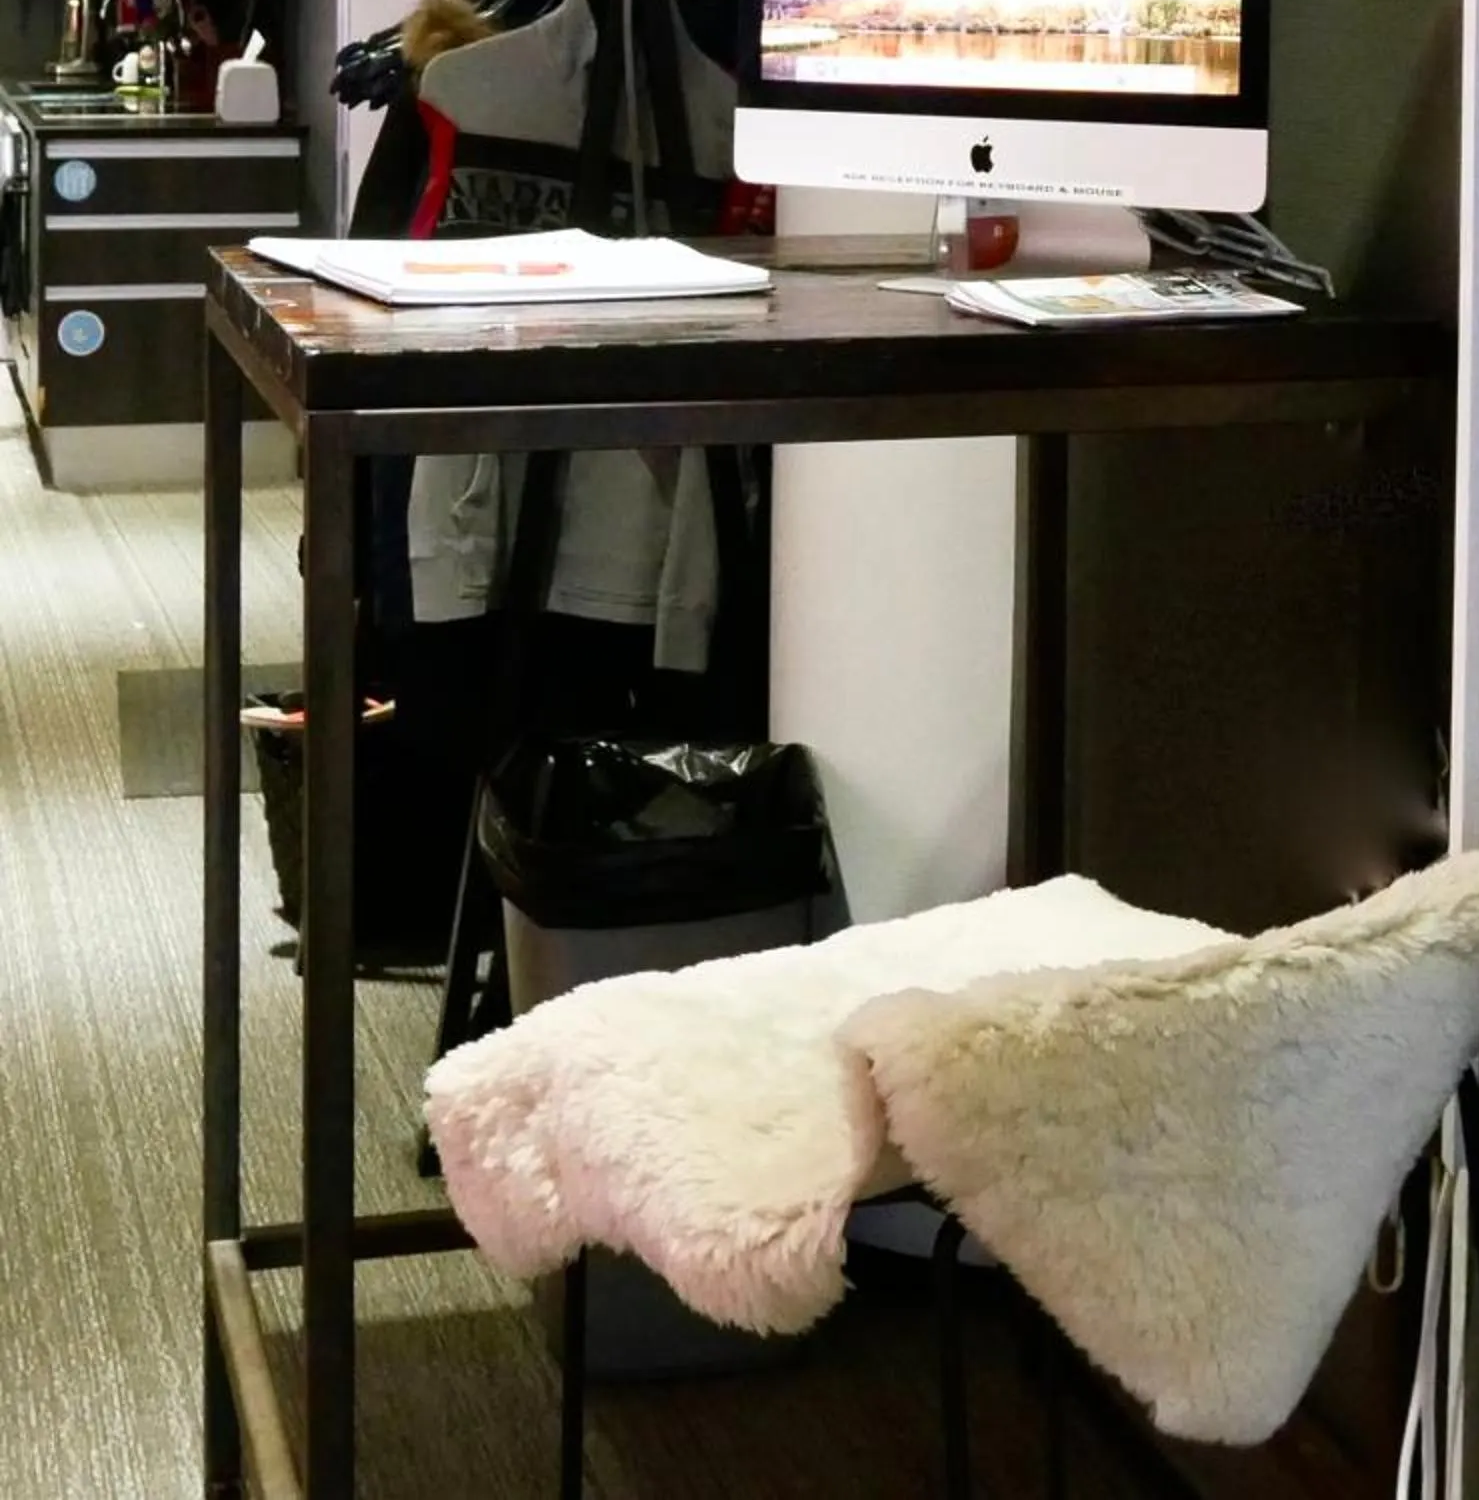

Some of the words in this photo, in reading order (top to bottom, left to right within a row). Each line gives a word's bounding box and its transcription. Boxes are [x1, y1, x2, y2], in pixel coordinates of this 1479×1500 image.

[948, 179, 975, 187] FOR
[979, 182, 1054, 194] KEYBOARD
[1073, 187, 1123, 197] MOUSE
